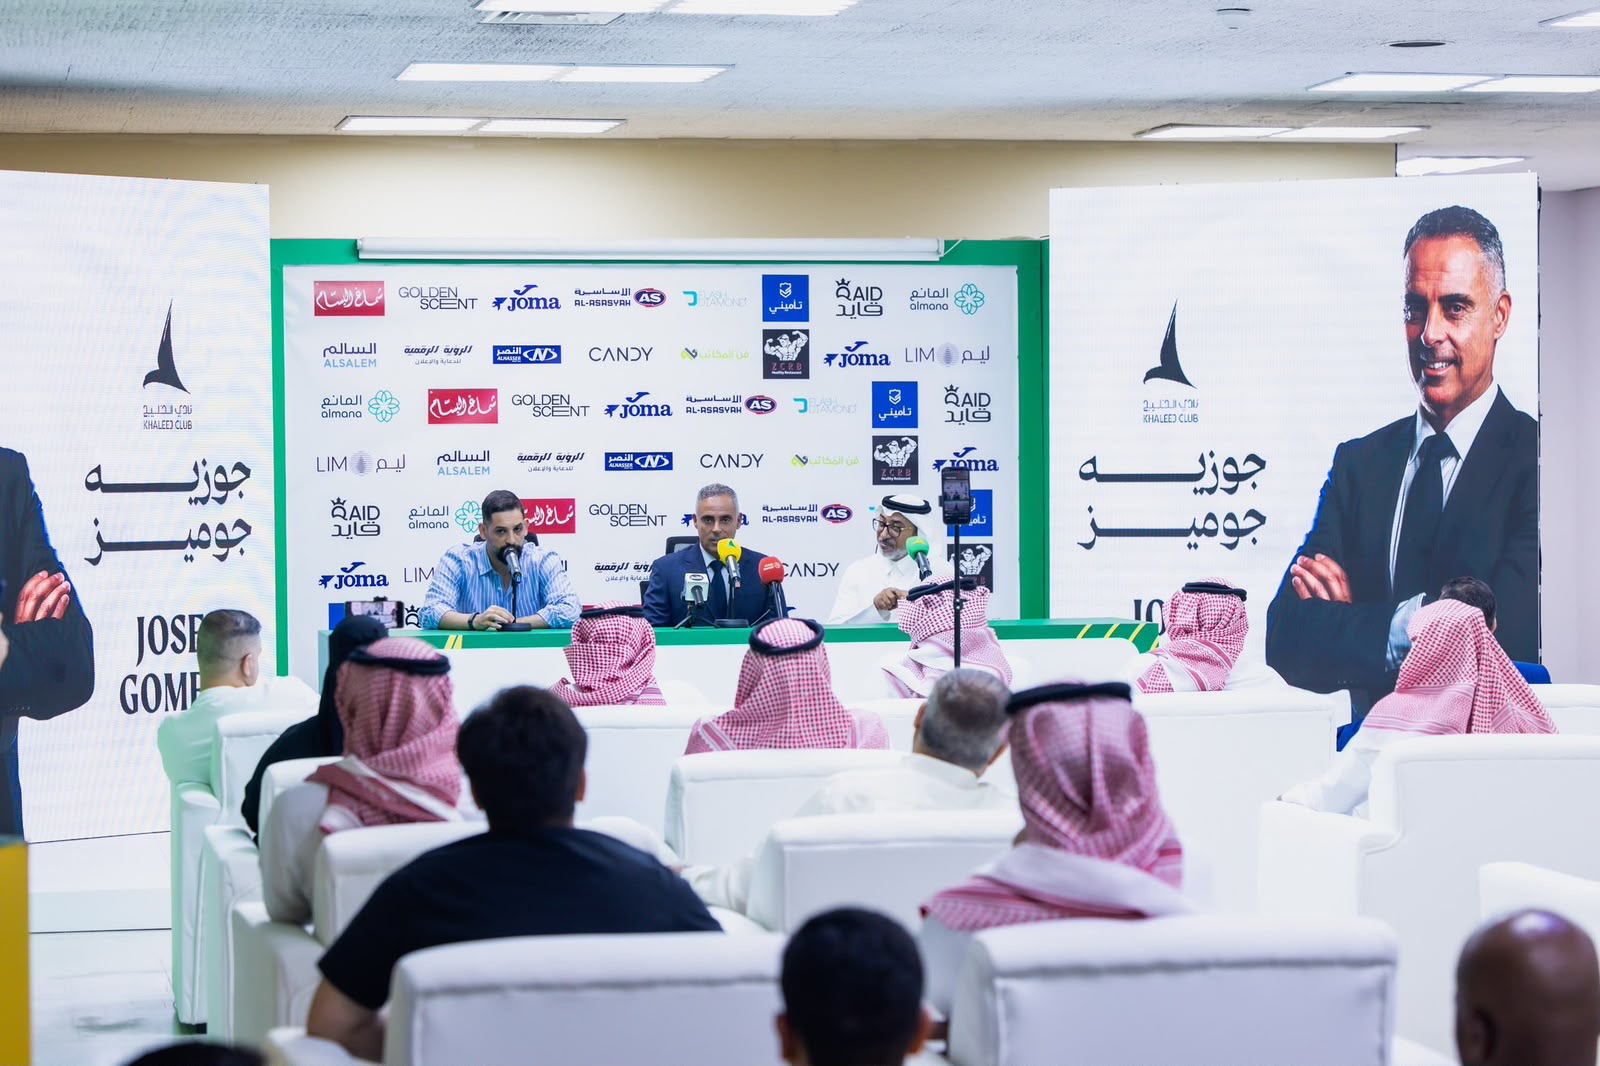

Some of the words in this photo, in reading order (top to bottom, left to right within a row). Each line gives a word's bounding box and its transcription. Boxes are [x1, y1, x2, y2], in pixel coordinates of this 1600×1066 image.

[399, 286, 458, 298] GOLDEN
[638, 293, 662, 304] AS
[836, 286, 883, 301] QAID
[909, 288, 949, 301] المانع
[420, 298, 478, 310] SCENT
[769, 301, 803, 315] تأميني
[836, 302, 883, 319] قايد
[909, 301, 949, 310] almana
[323, 343, 377, 358] السالم
[404, 345, 439, 356] الرقمية
[496, 346, 522, 356] النصر
[588, 346, 654, 362] CANDY
[905, 347, 935, 363] LIM
[961, 346, 990, 364] ليم
[323, 358, 377, 368] ALSALEM
[321, 394, 362, 410] المانع
[468, 395, 497, 415] شماغ
[512, 394, 570, 406] GOLDEN
[749, 398, 772, 410] AS
[944, 393, 991, 408] QAID
[321, 409, 362, 418] almana
[532, 406, 590, 418] SCENT
[686, 406, 742, 414] AL-ASASYAH
[878, 406, 912, 422] تأميني
[944, 408, 991, 426] قايد
[174, 419, 193, 430] CLUB
[1178, 414, 1199, 424] CLUB
[316, 456, 348, 472] LIM
[376, 454, 406, 473] ليم
[437, 450, 490, 466] السالم
[517, 452, 552, 464] الرقمية
[608, 454, 634, 464] النصر
[700, 453, 764, 469] CANDY
[437, 466, 490, 476] ALSALEM
[1078, 450, 1267, 496] جوزيه
[84, 457, 252, 506] جوزيه
[331, 505, 381, 521] QAID
[408, 506, 449, 520] المانع
[545, 504, 574, 526] شماغ
[589, 504, 648, 516] GOLDEN
[826, 508, 848, 519] AS
[408, 520, 450, 530] almana
[610, 515, 668, 527] SCENT
[1076, 505, 1267, 551] جوميز
[331, 521, 381, 540] قايد
[83, 514, 253, 567] جوميز
[594, 562, 630, 574] الرقمية
